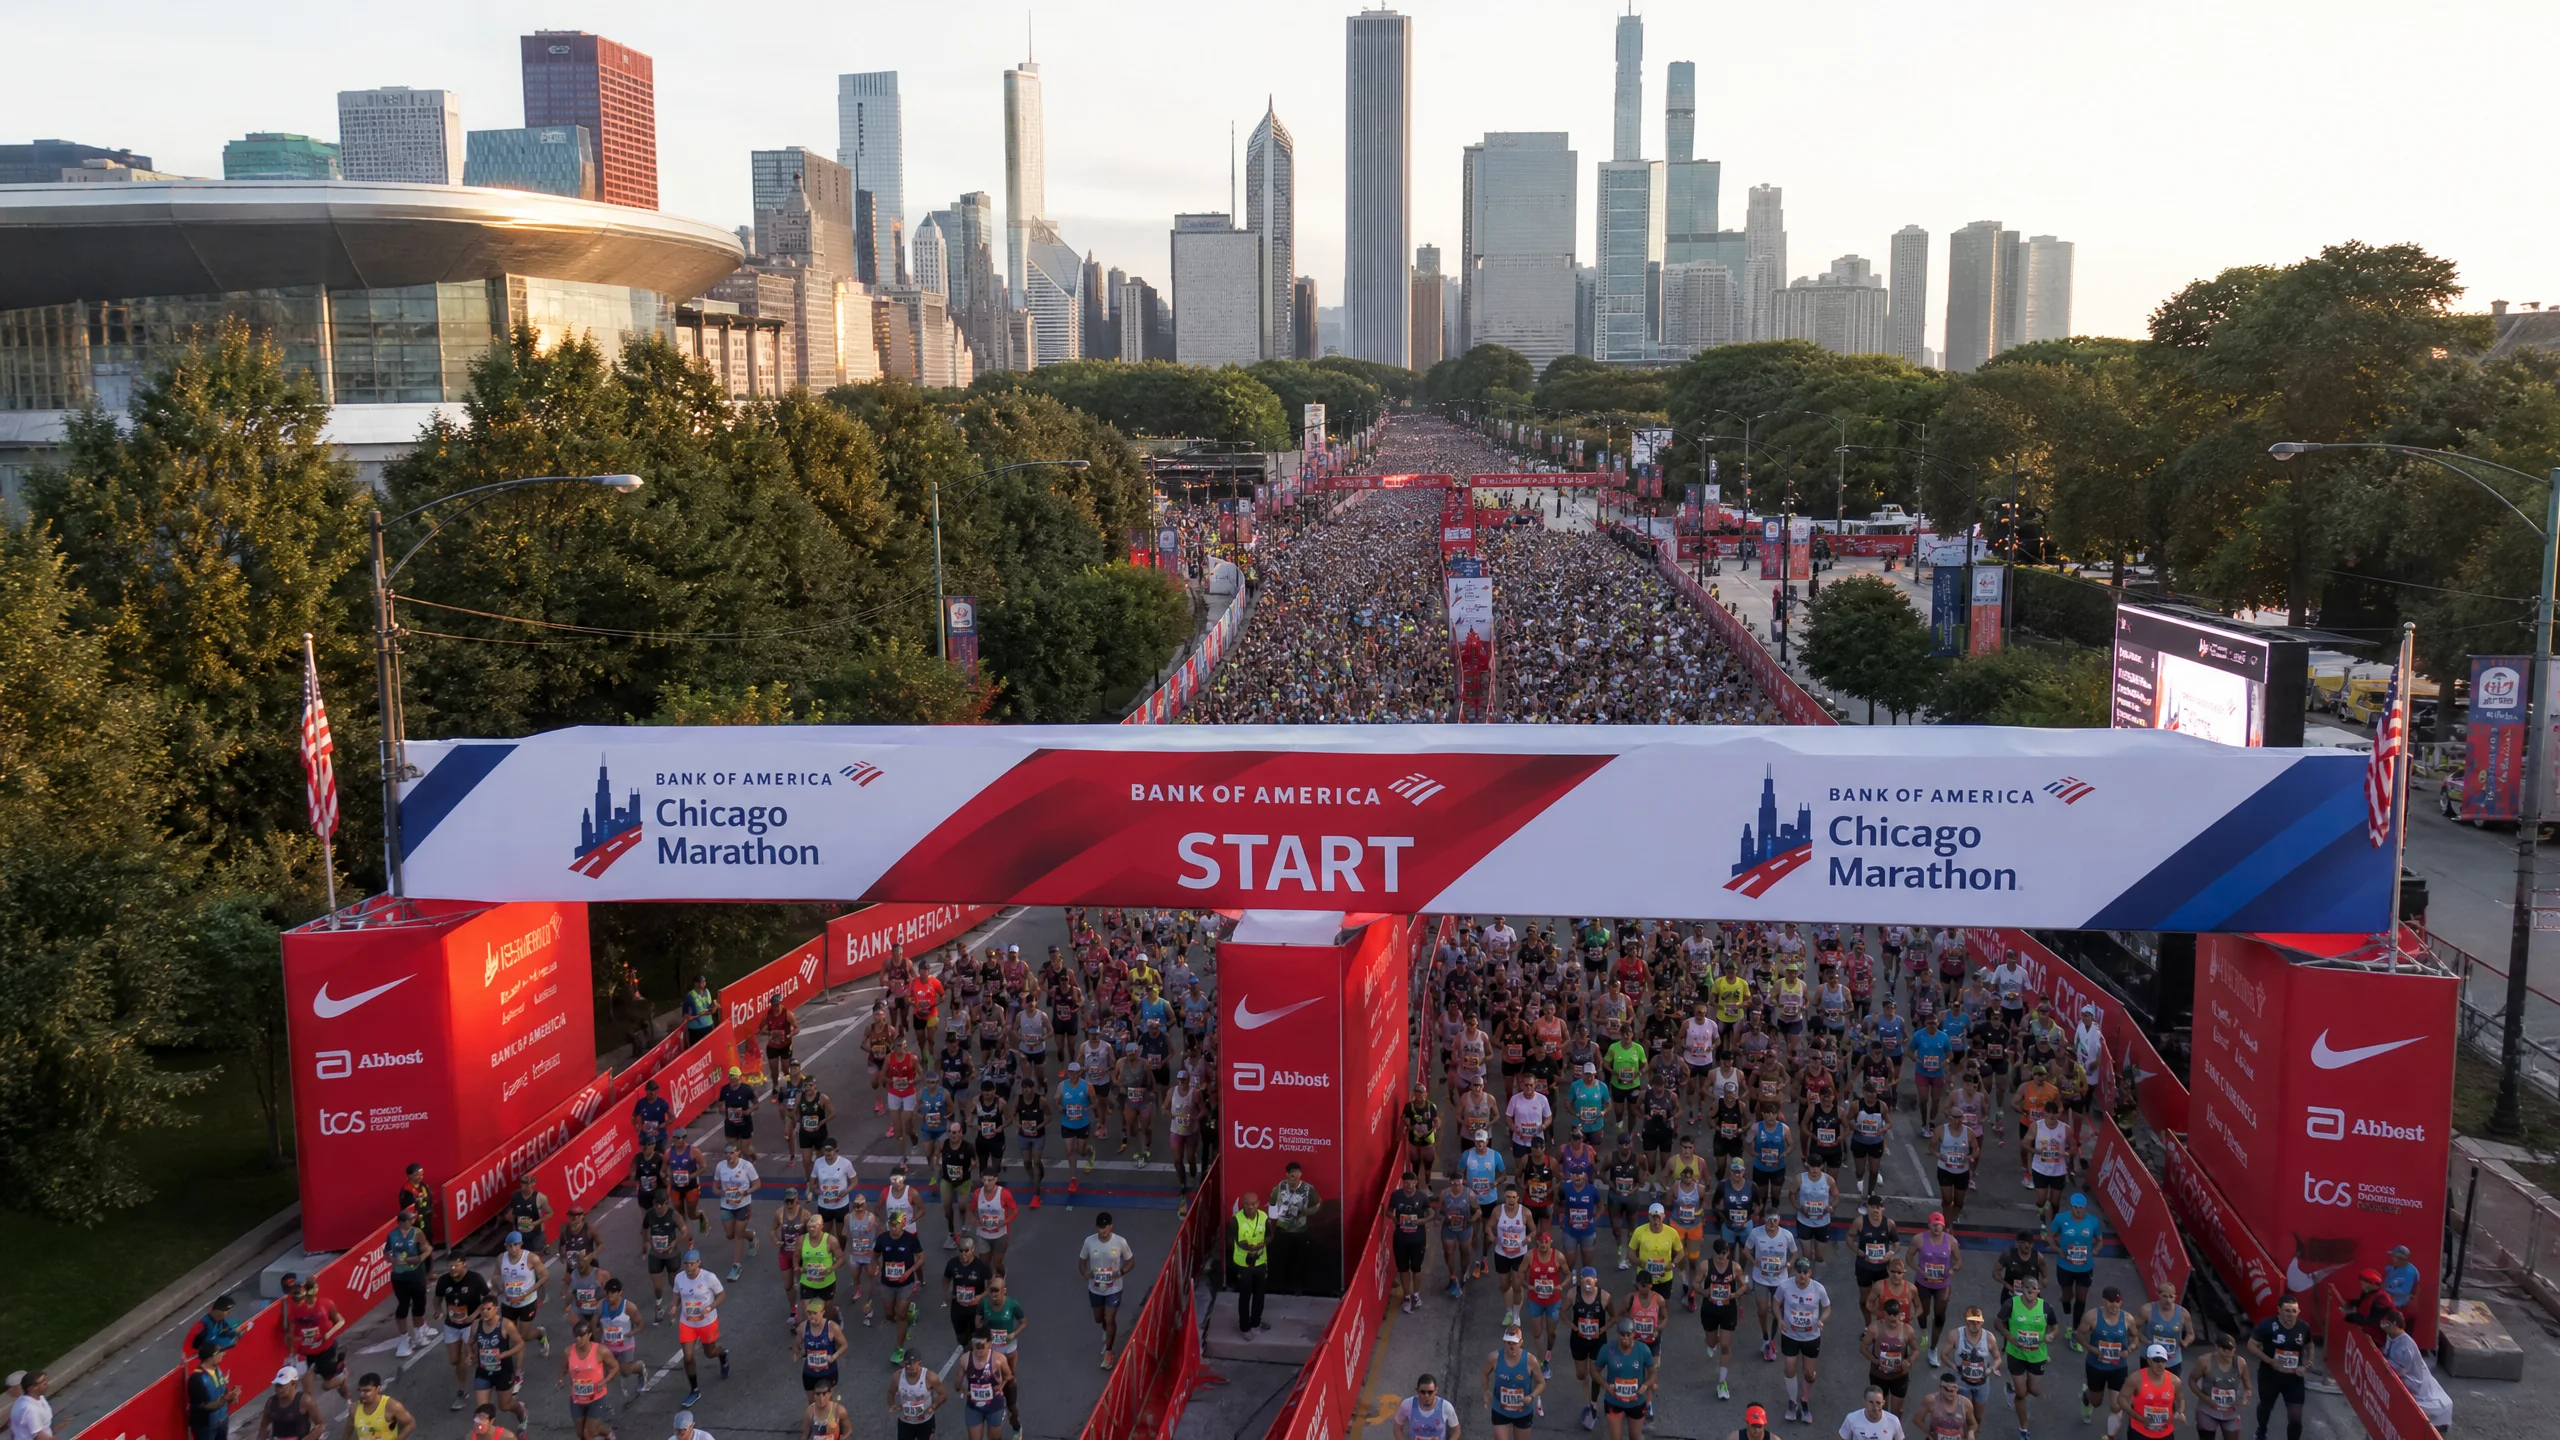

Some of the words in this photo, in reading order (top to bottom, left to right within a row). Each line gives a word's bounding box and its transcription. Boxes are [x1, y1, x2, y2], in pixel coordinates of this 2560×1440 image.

[656, 772, 707, 787] BANK
[713, 772, 738, 787] OF
[743, 772, 833, 787] AMERICA
[1131, 783, 1205, 803] BANK
[1213, 785, 1246, 804] OF
[1253, 786, 1381, 806] AMERICA
[1829, 787, 1888, 803] BANK
[1895, 788, 1924, 803] OF
[1930, 789, 2035, 805] AMERICA
[656, 798, 788, 836] Chicago
[656, 834, 820, 866] Marathon
[1828, 815, 1982, 858] Chicago
[1177, 832, 1415, 893] START
[1828, 857, 2017, 891] Marathon
[319, 1108, 366, 1136] tcs
[1234, 1120, 1274, 1150] tcs
[2304, 1171, 2352, 1207] tcs
